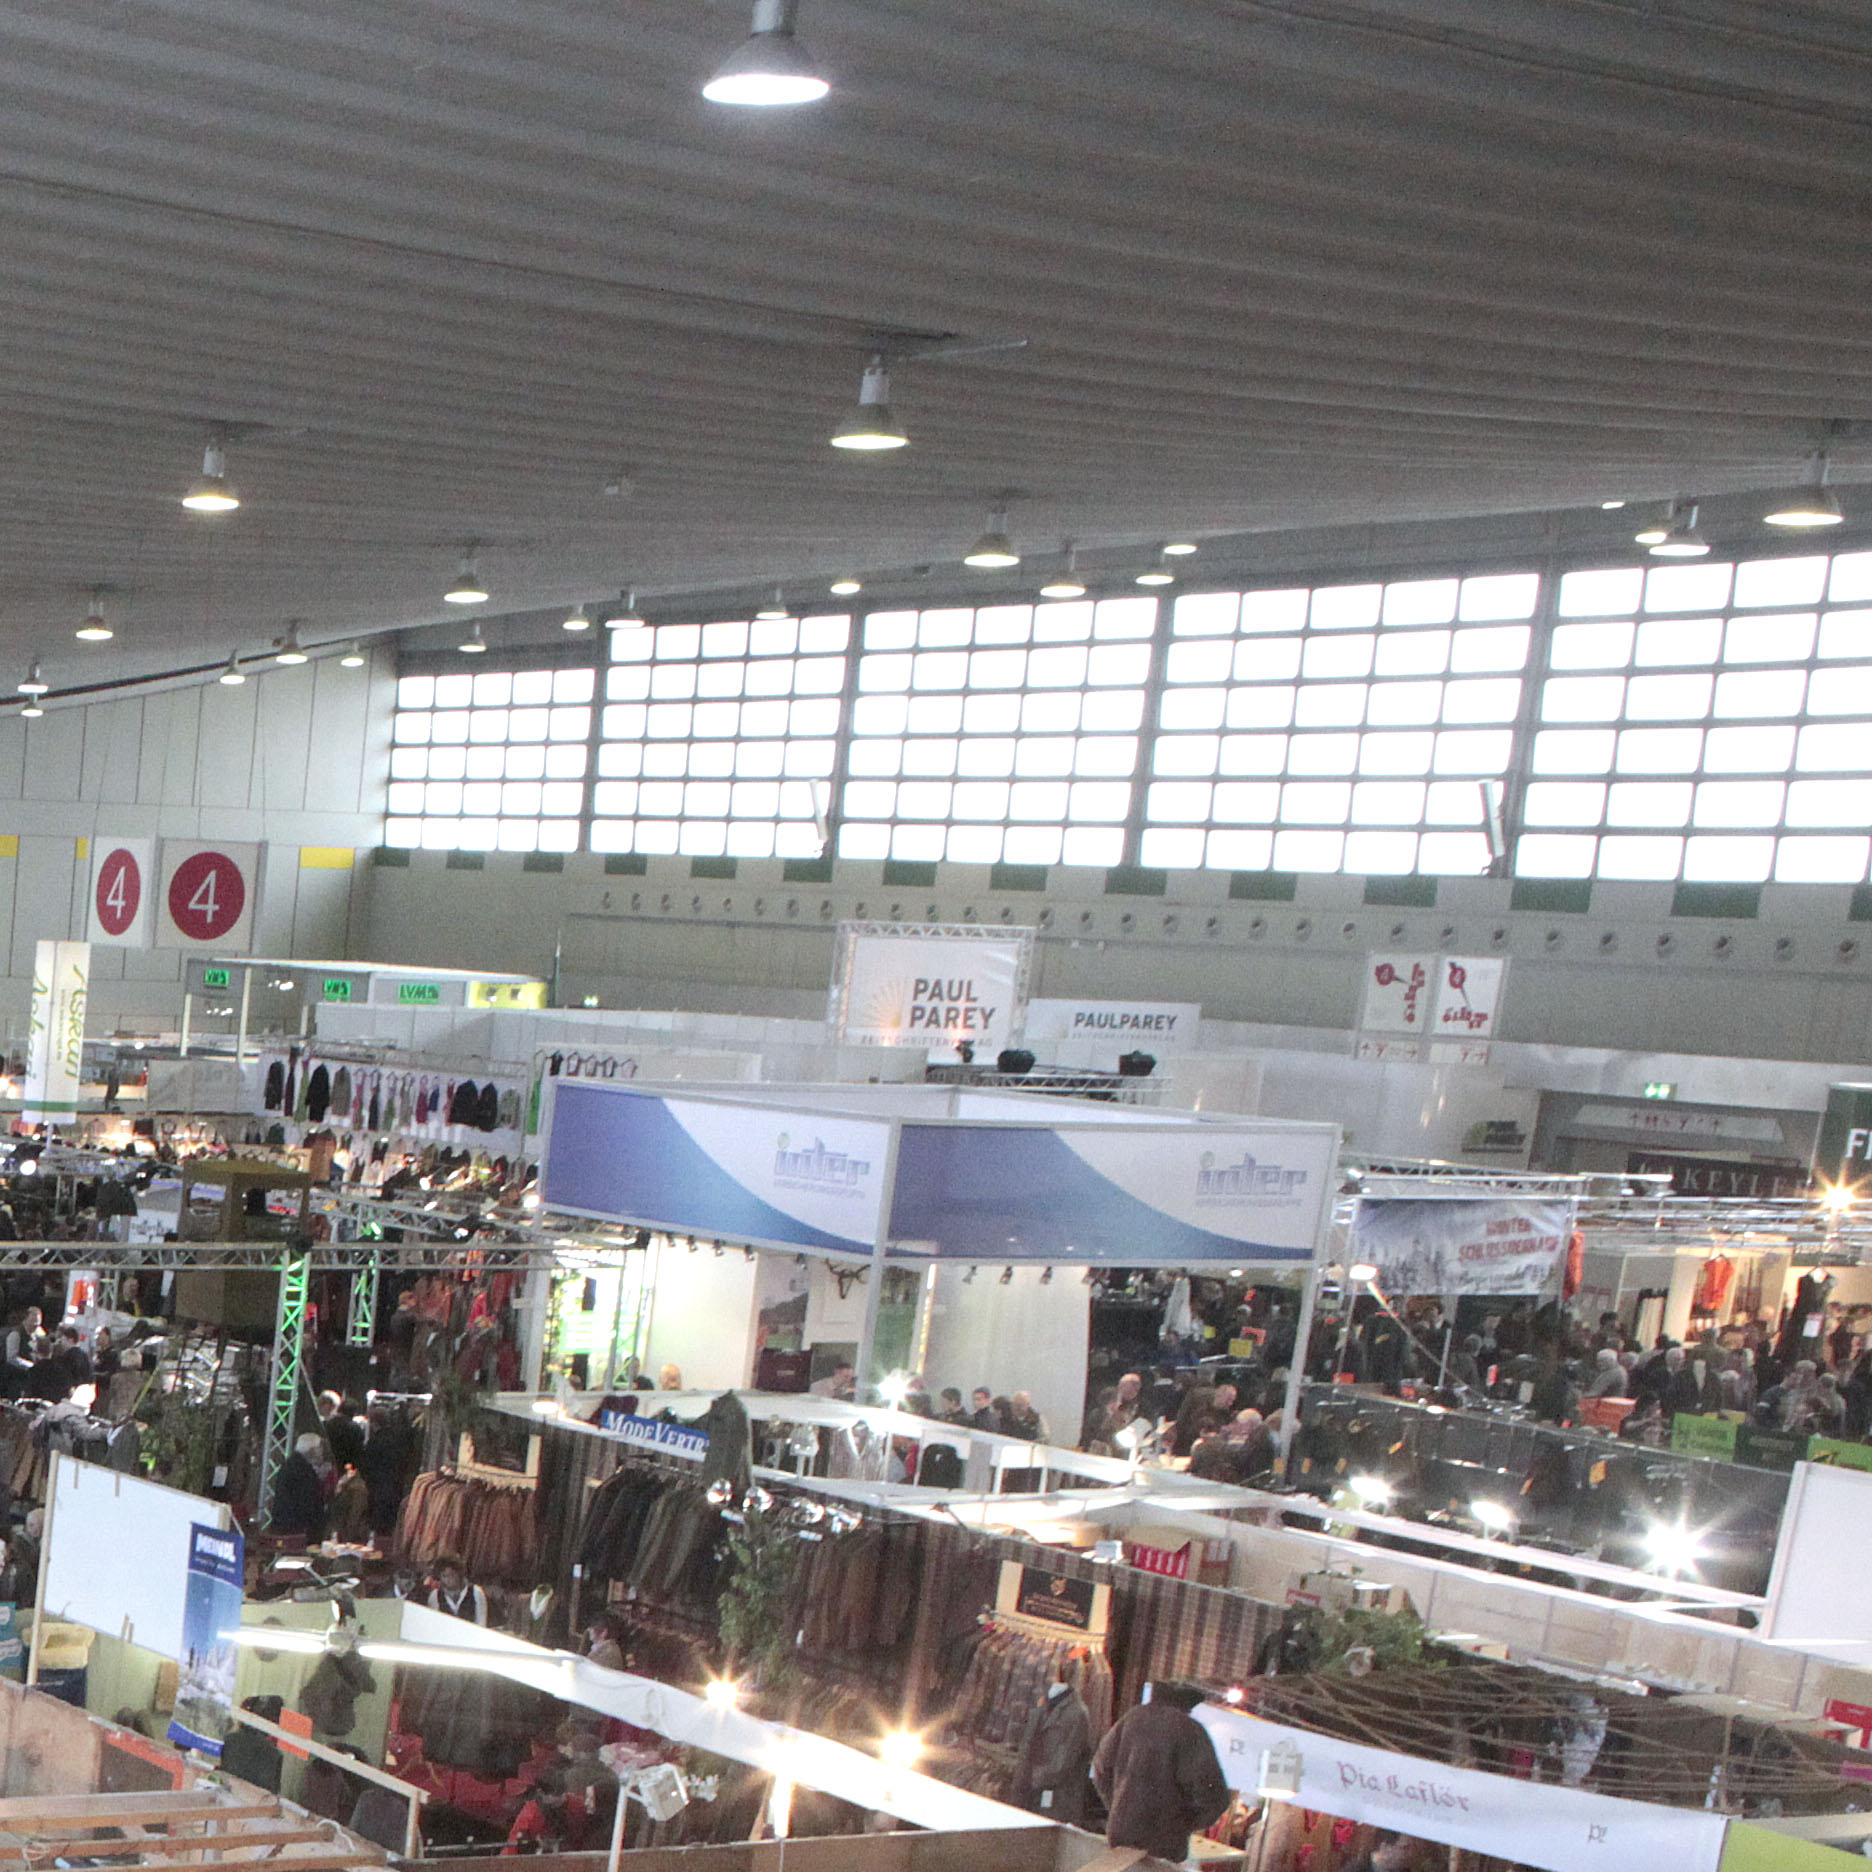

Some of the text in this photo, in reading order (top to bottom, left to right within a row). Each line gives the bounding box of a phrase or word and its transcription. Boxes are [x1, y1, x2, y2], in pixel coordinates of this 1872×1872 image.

[106, 865, 126, 920] 4
[187, 869, 220, 923] 4
[912, 978, 978, 1003] PAUL
[909, 1005, 996, 1030] PAREY
[1073, 1012, 1178, 1031] PAULPAREY
